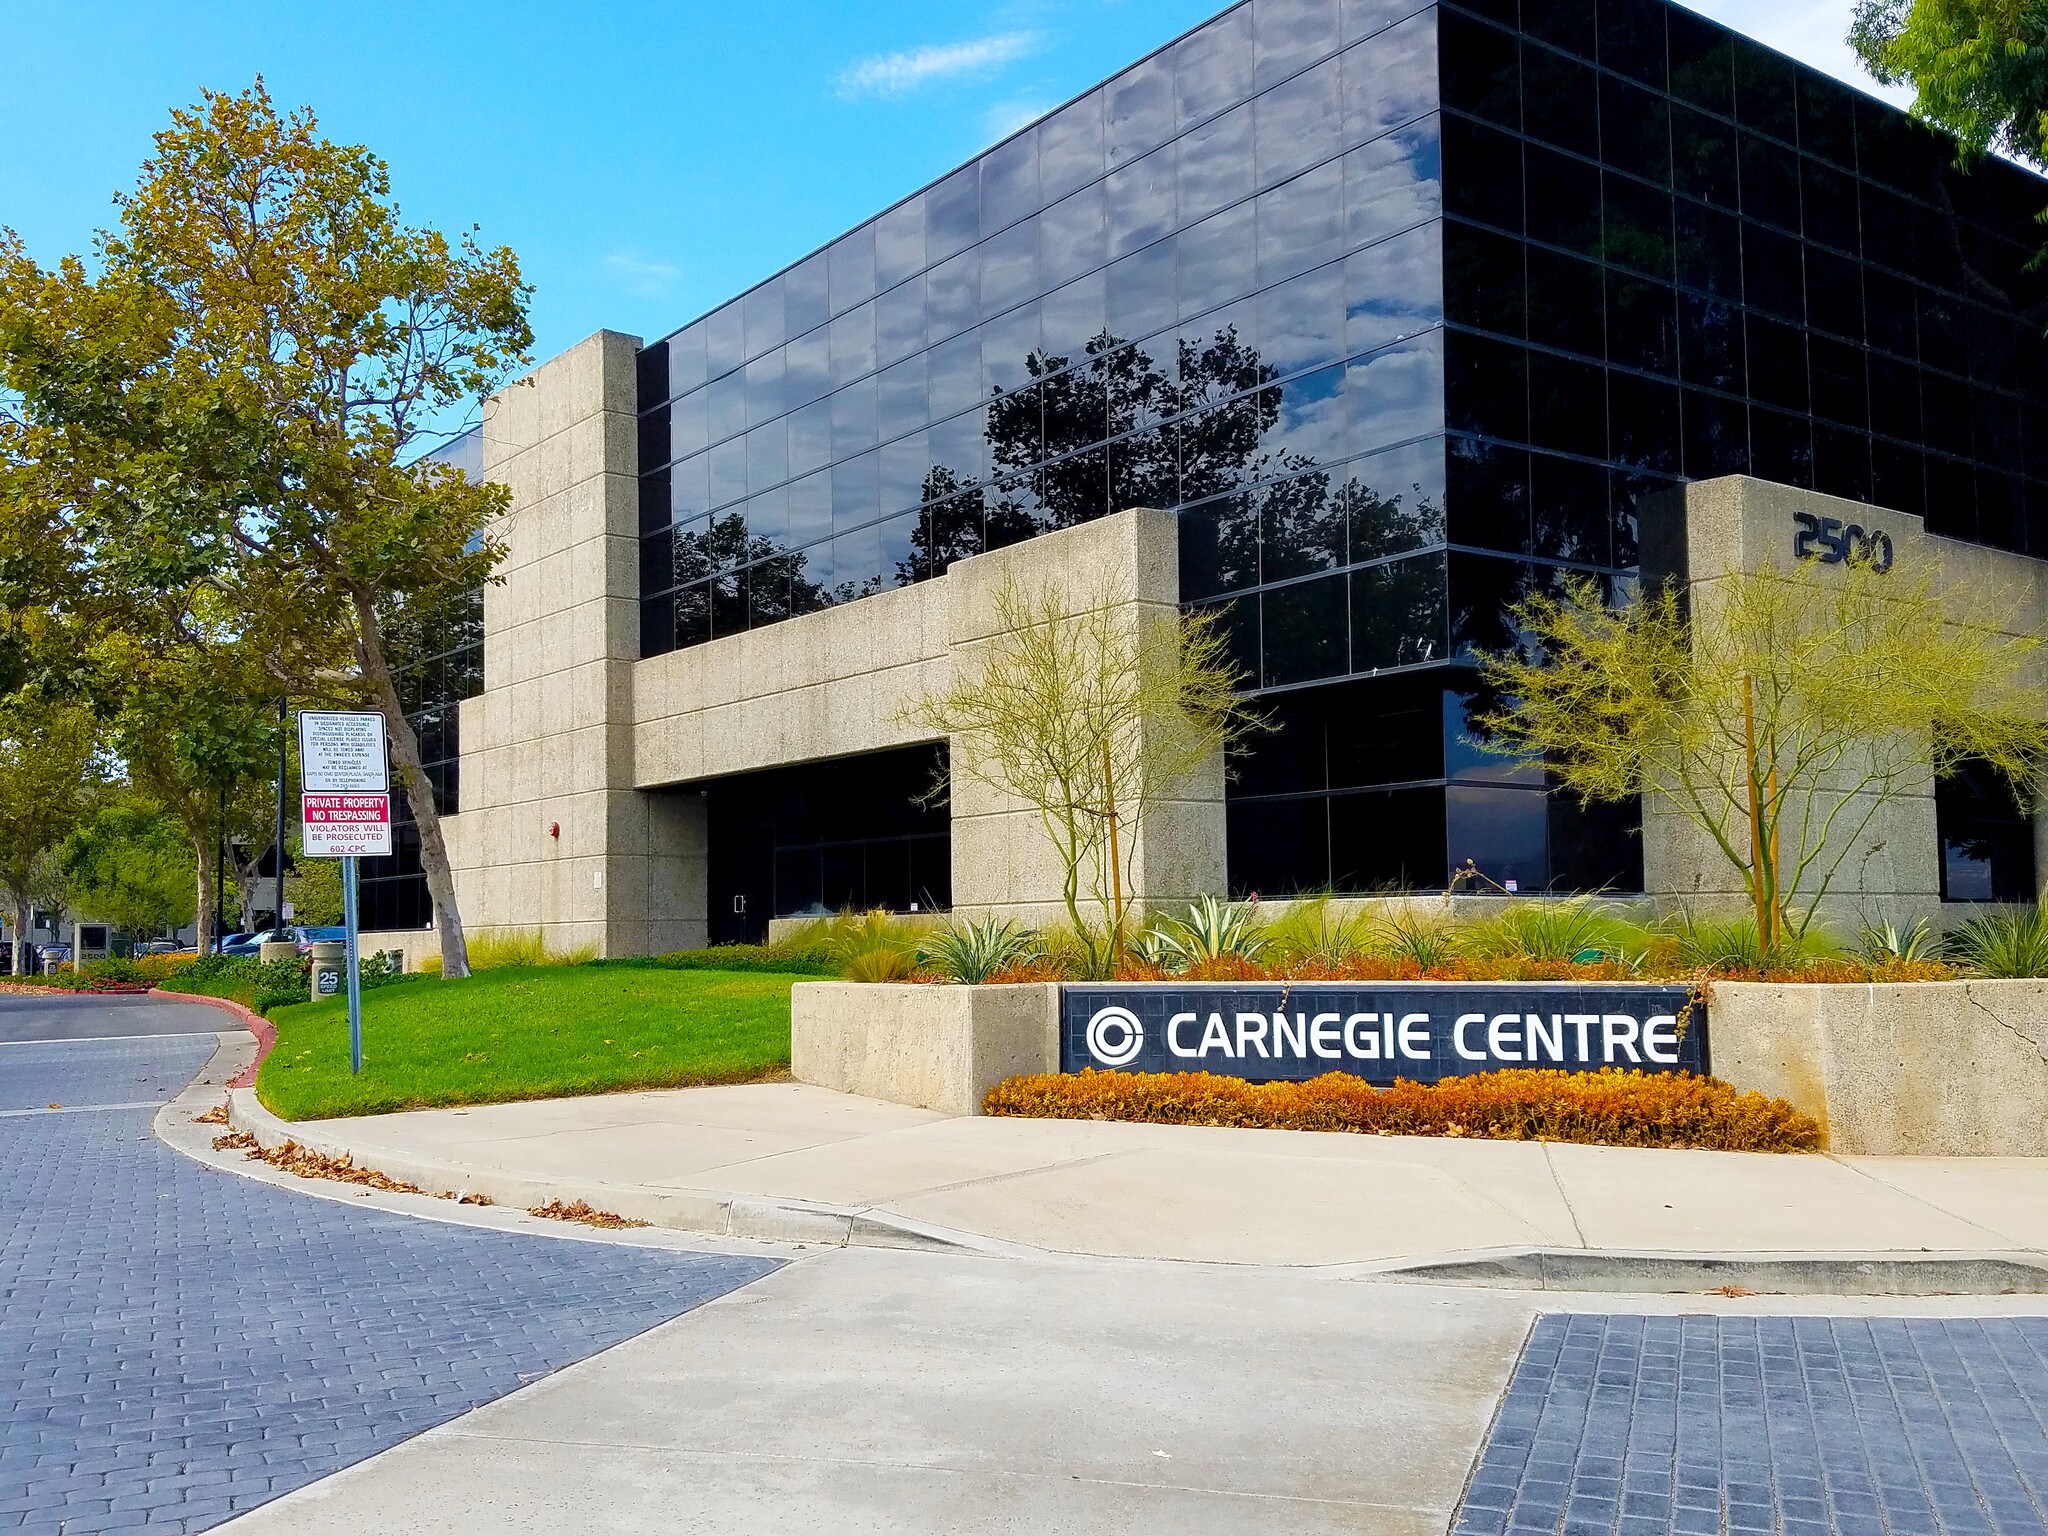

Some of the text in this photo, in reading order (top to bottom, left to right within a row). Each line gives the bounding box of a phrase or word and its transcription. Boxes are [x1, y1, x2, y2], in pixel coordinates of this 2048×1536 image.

[1793, 511, 1893, 575] 2500
[307, 798, 385, 808] PRIVATE PROPERTY
[312, 810, 381, 820] NO TRESPASSING
[320, 972, 338, 984] 25
[1167, 1012, 1678, 1063] CARNEGIE CENTRE
